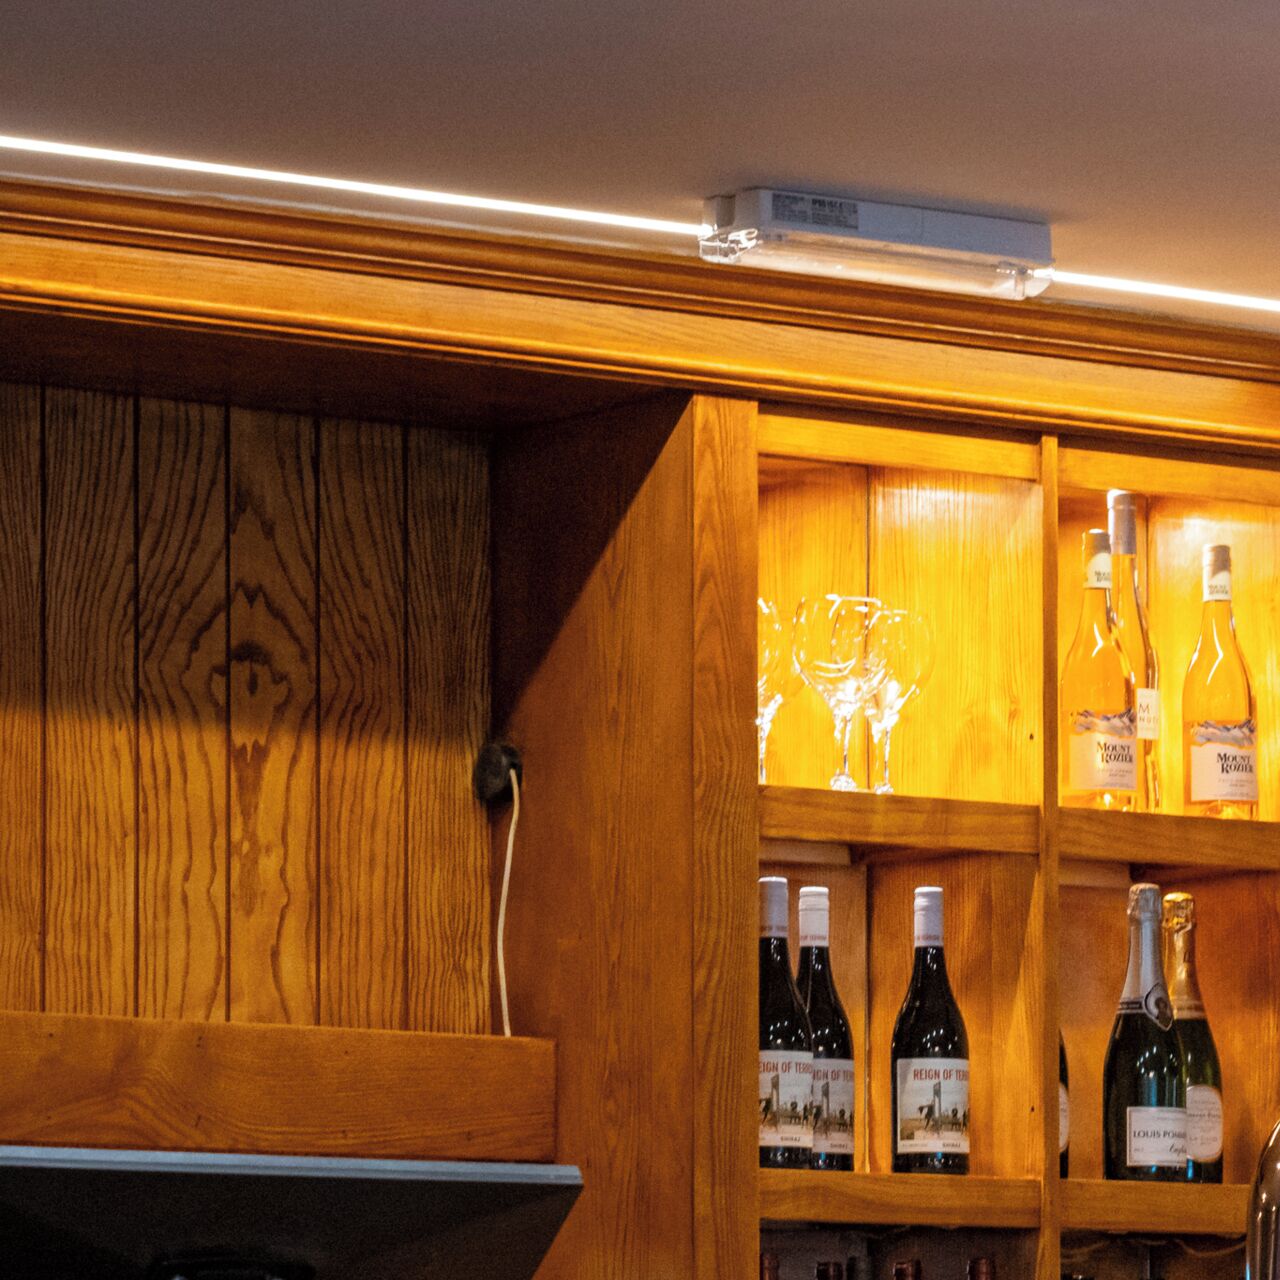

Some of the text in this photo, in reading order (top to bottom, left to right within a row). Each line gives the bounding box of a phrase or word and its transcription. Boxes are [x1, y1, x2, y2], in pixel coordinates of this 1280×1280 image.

[1097, 741, 1131, 754] MOUNT
[1101, 752, 1134, 763] ROZIER
[1217, 752, 1251, 764] MOUNT
[1221, 763, 1254, 774] ROZIER
[781, 1061, 793, 1074] OF
[830, 1069, 842, 1081] OF
[913, 1068, 941, 1080] REIGN
[942, 1068, 953, 1080] OF
[1133, 1130, 1161, 1139] LOUIS
